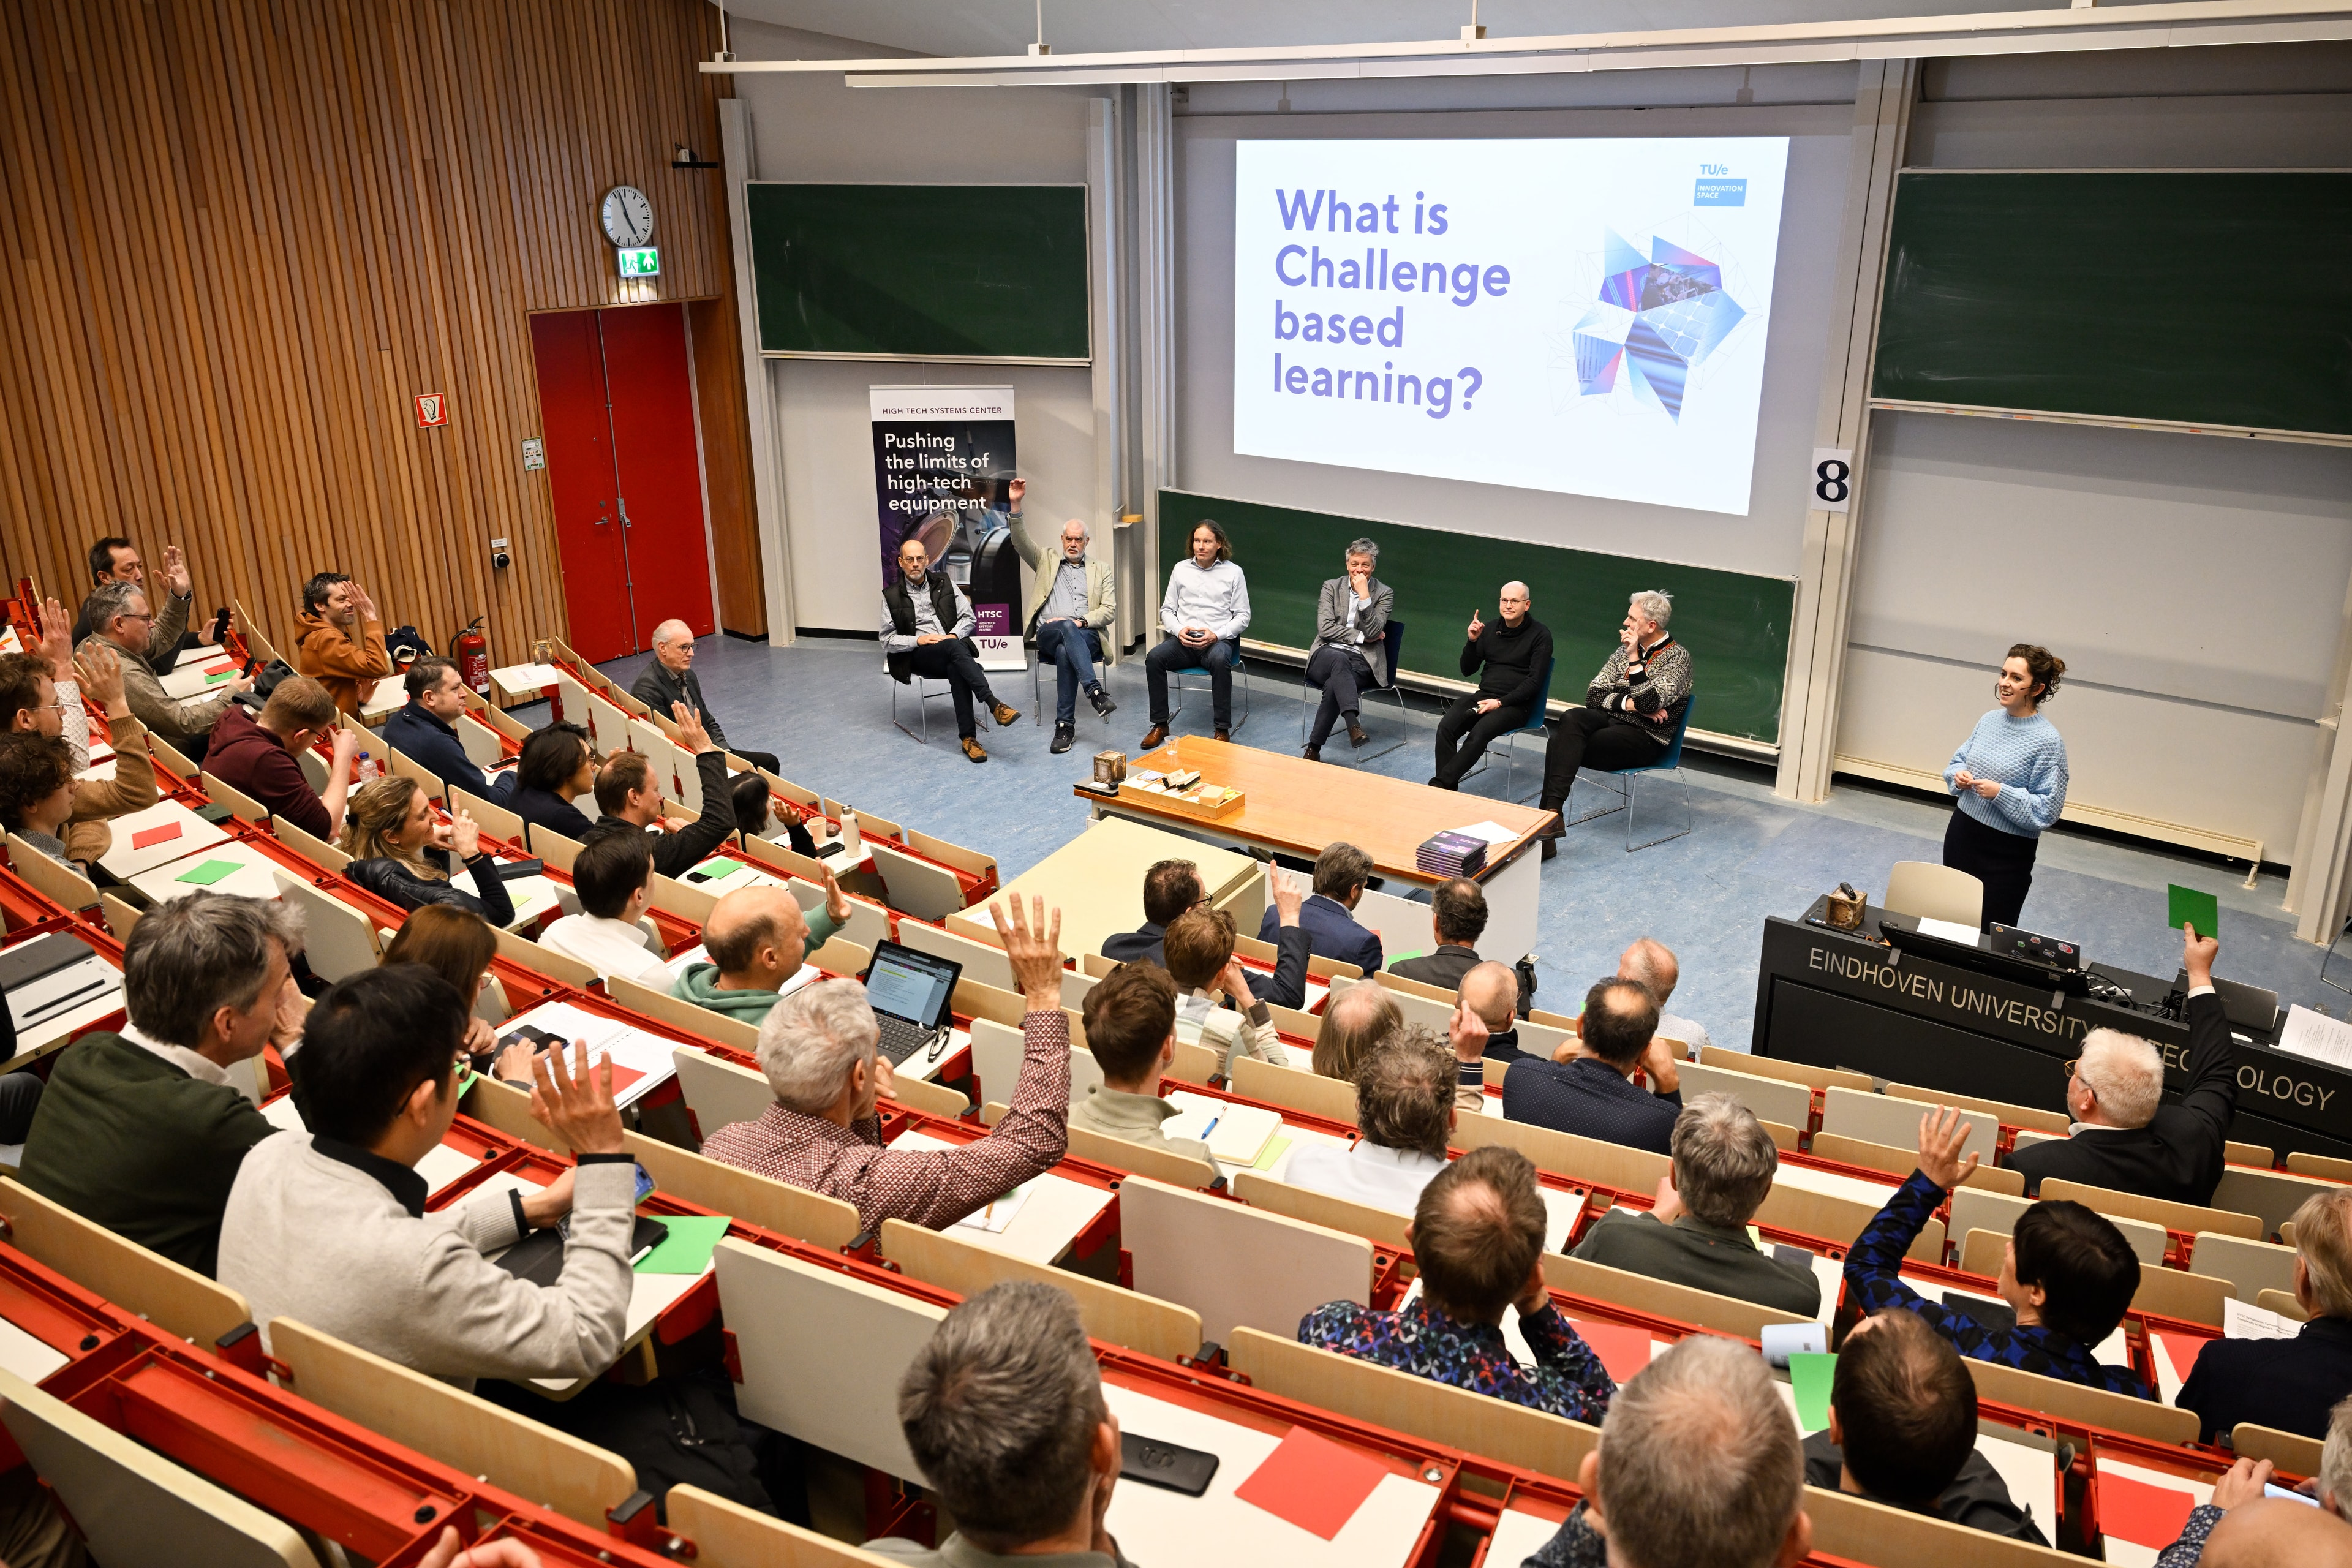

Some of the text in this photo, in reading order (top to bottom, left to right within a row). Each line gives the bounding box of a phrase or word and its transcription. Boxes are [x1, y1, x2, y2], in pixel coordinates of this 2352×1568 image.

[1700, 164, 1728, 176] TU/e
[1275, 189, 1449, 235] What is
[1275, 244, 1510, 307] Challenge
[1275, 299, 1404, 348] based
[1274, 352, 1483, 420] learning?
[884, 432, 955, 452] Pushing
[885, 452, 989, 469] the limits of
[888, 473, 971, 494] high-tech
[1816, 459, 1849, 502] 8
[889, 495, 986, 514] equipment
[979, 638, 1008, 650] TU/e
[1809, 947, 1944, 1003] EINDHOVEN
[1951, 985, 2099, 1039] UNIVERSITY
